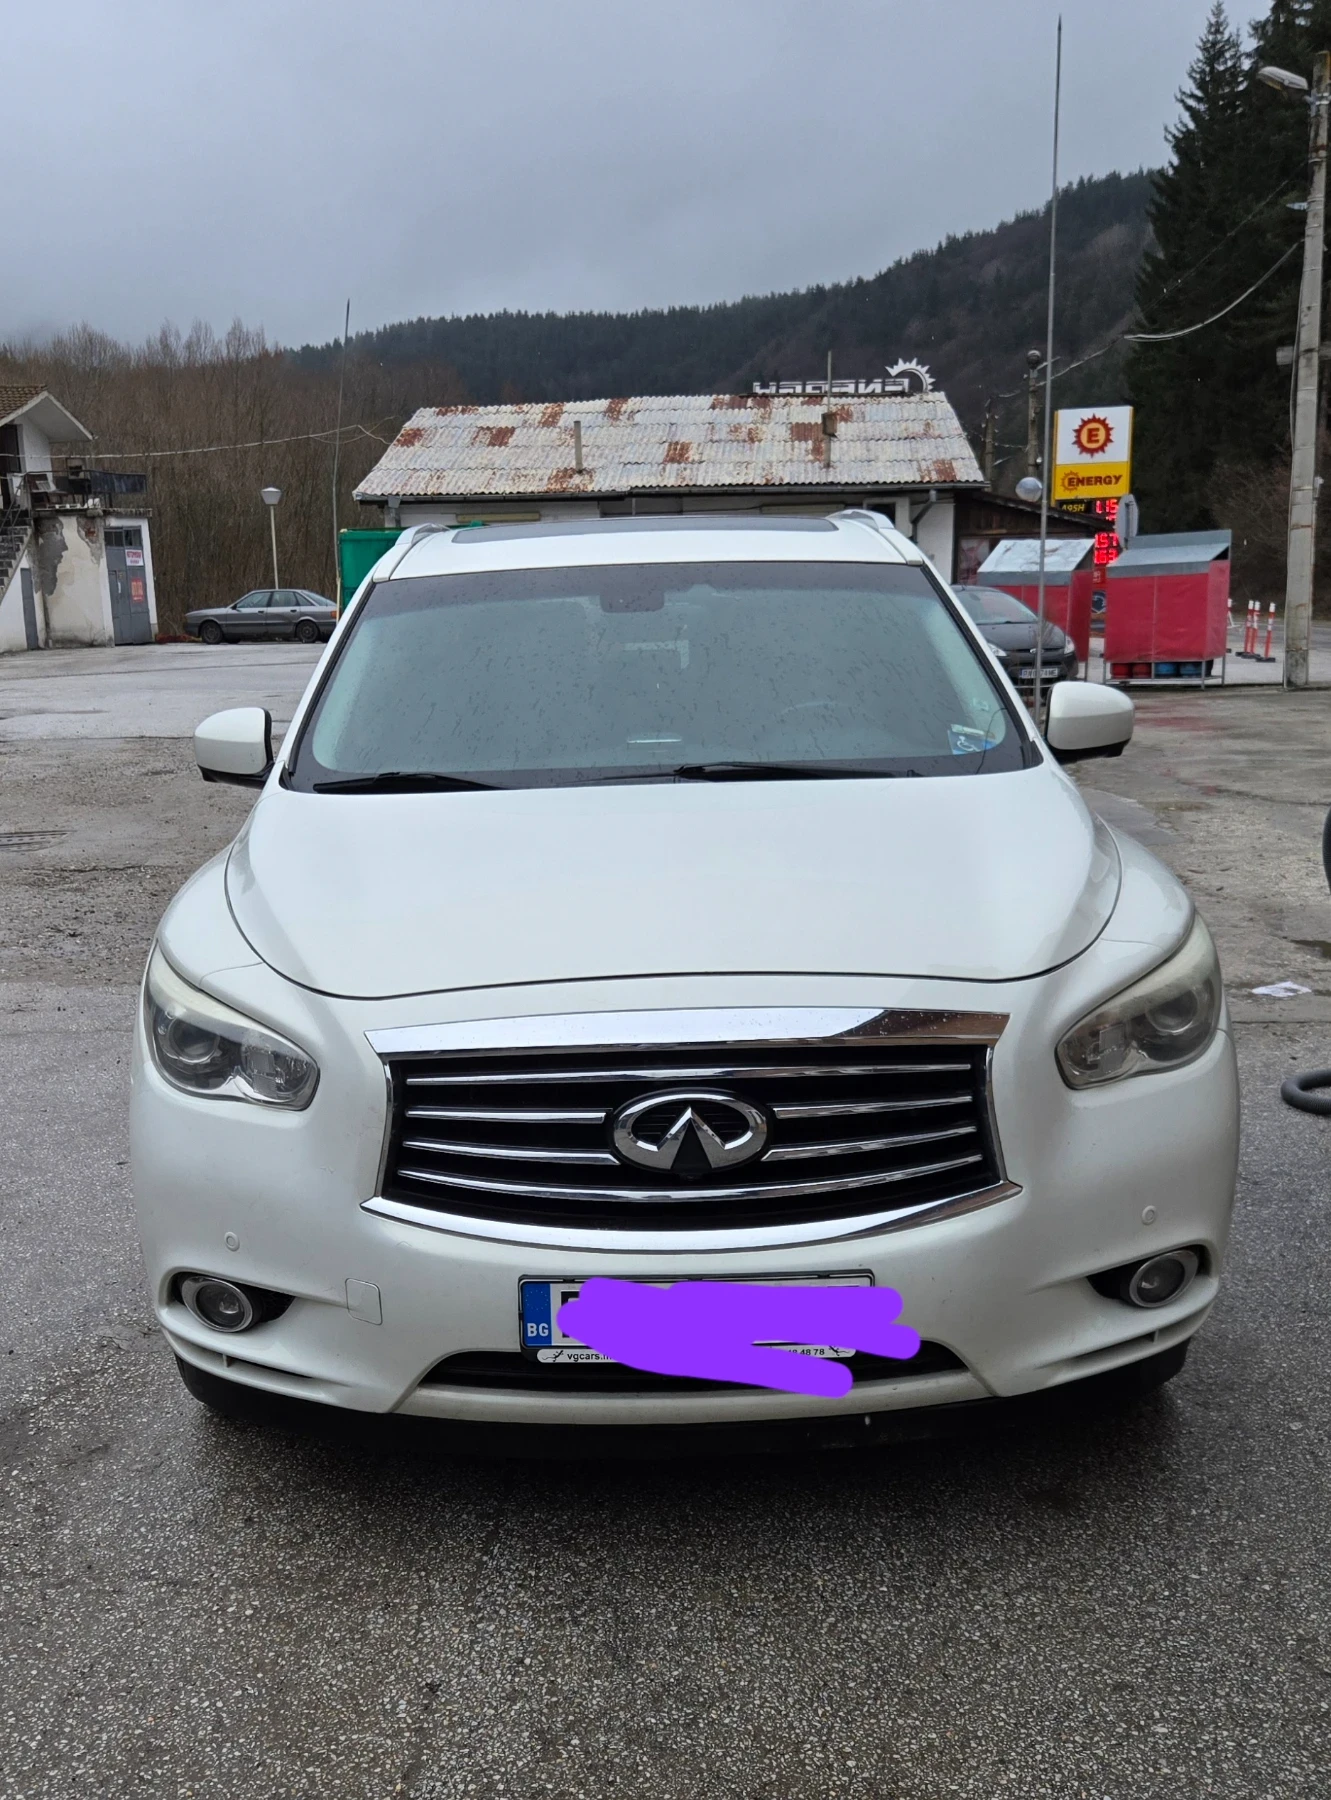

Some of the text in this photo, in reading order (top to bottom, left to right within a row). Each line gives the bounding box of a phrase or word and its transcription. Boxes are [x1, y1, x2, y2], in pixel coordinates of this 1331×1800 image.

[1086, 427, 1101, 444] E
[1067, 474, 1123, 487] ENERGY
[527, 1323, 549, 1337] BG
[813, 1348, 825, 1356] 78
